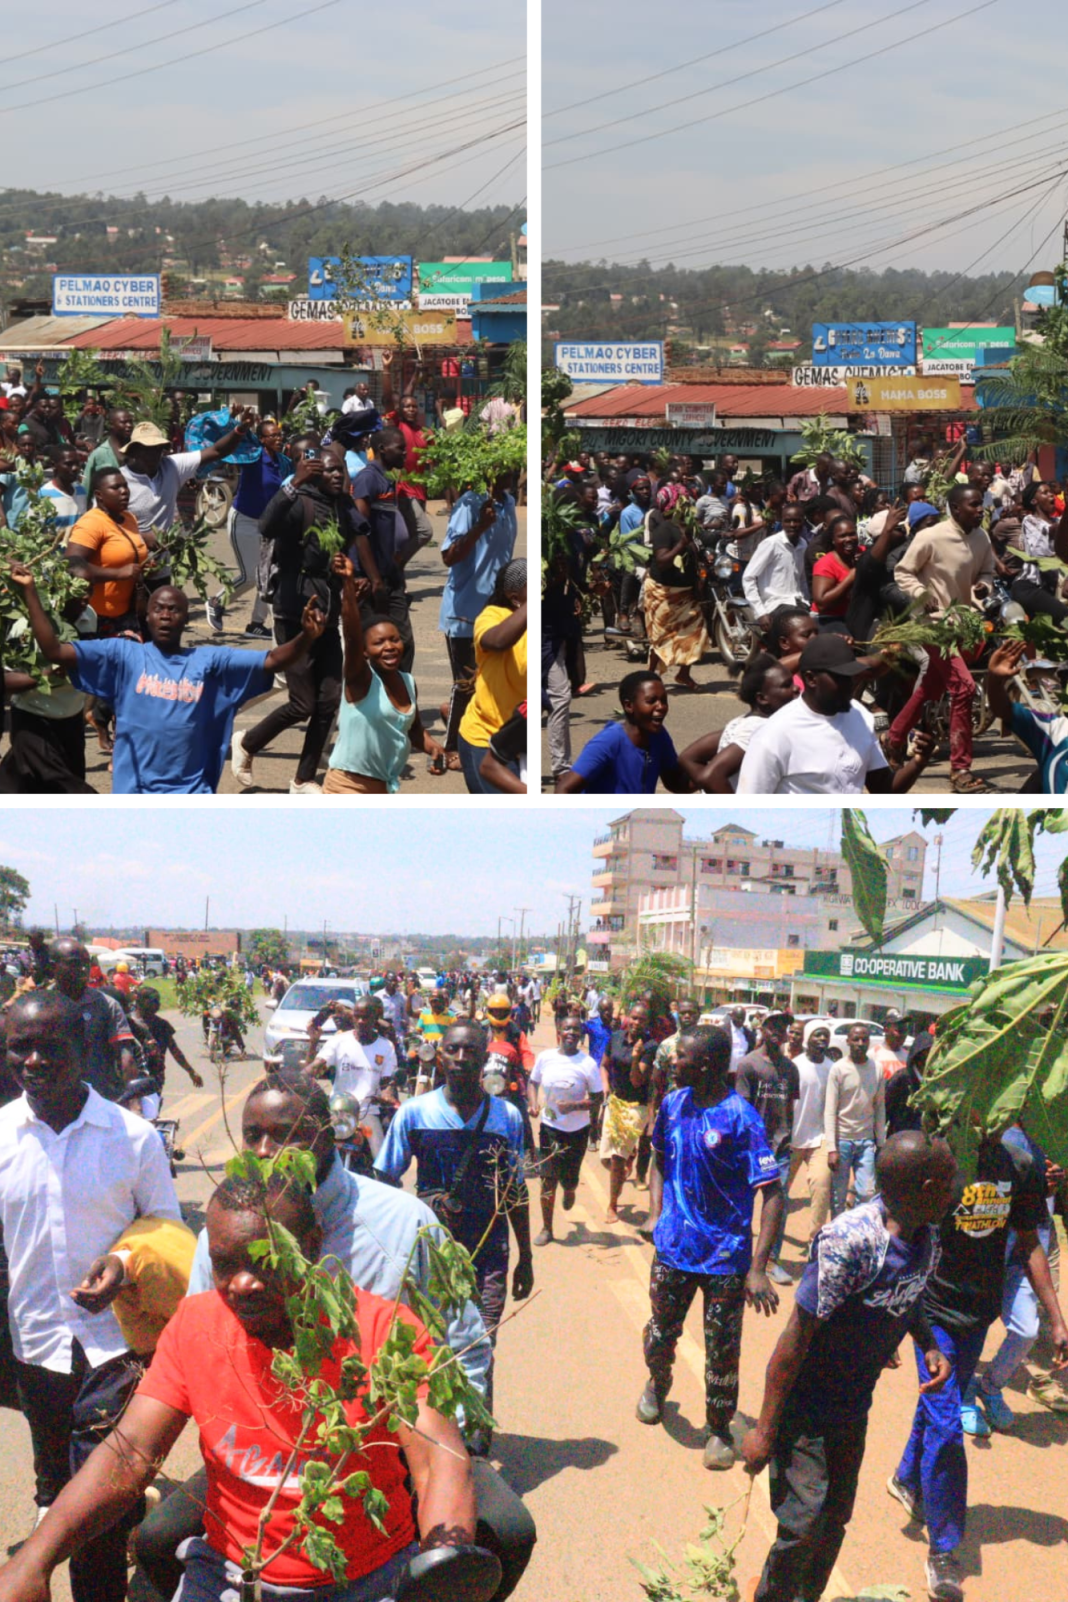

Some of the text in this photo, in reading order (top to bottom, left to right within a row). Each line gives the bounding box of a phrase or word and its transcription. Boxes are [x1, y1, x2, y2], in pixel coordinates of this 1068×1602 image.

[60, 279, 155, 293] PELMAQ CYBER
[66, 295, 120, 307] STATIONERS
[122, 296, 157, 308] CENTRE
[424, 298, 459, 306] JACATOBE
[290, 301, 335, 320] GEMAS
[413, 323, 444, 335] BOSS
[935, 339, 976, 350] Safaricom
[561, 346, 658, 359] PELMAQ CYBER
[567, 362, 622, 374] STATIONERS
[624, 363, 660, 374] CENTRE
[927, 363, 964, 372] JACATOBE
[795, 366, 839, 386] GEMAS
[881, 388, 947, 401] MAMA BOSS
[604, 429, 647, 446] MIGORI
[650, 429, 694, 447] COUNTY
[927, 961, 966, 982] BANK
[961, 1183, 997, 1206] 8th
